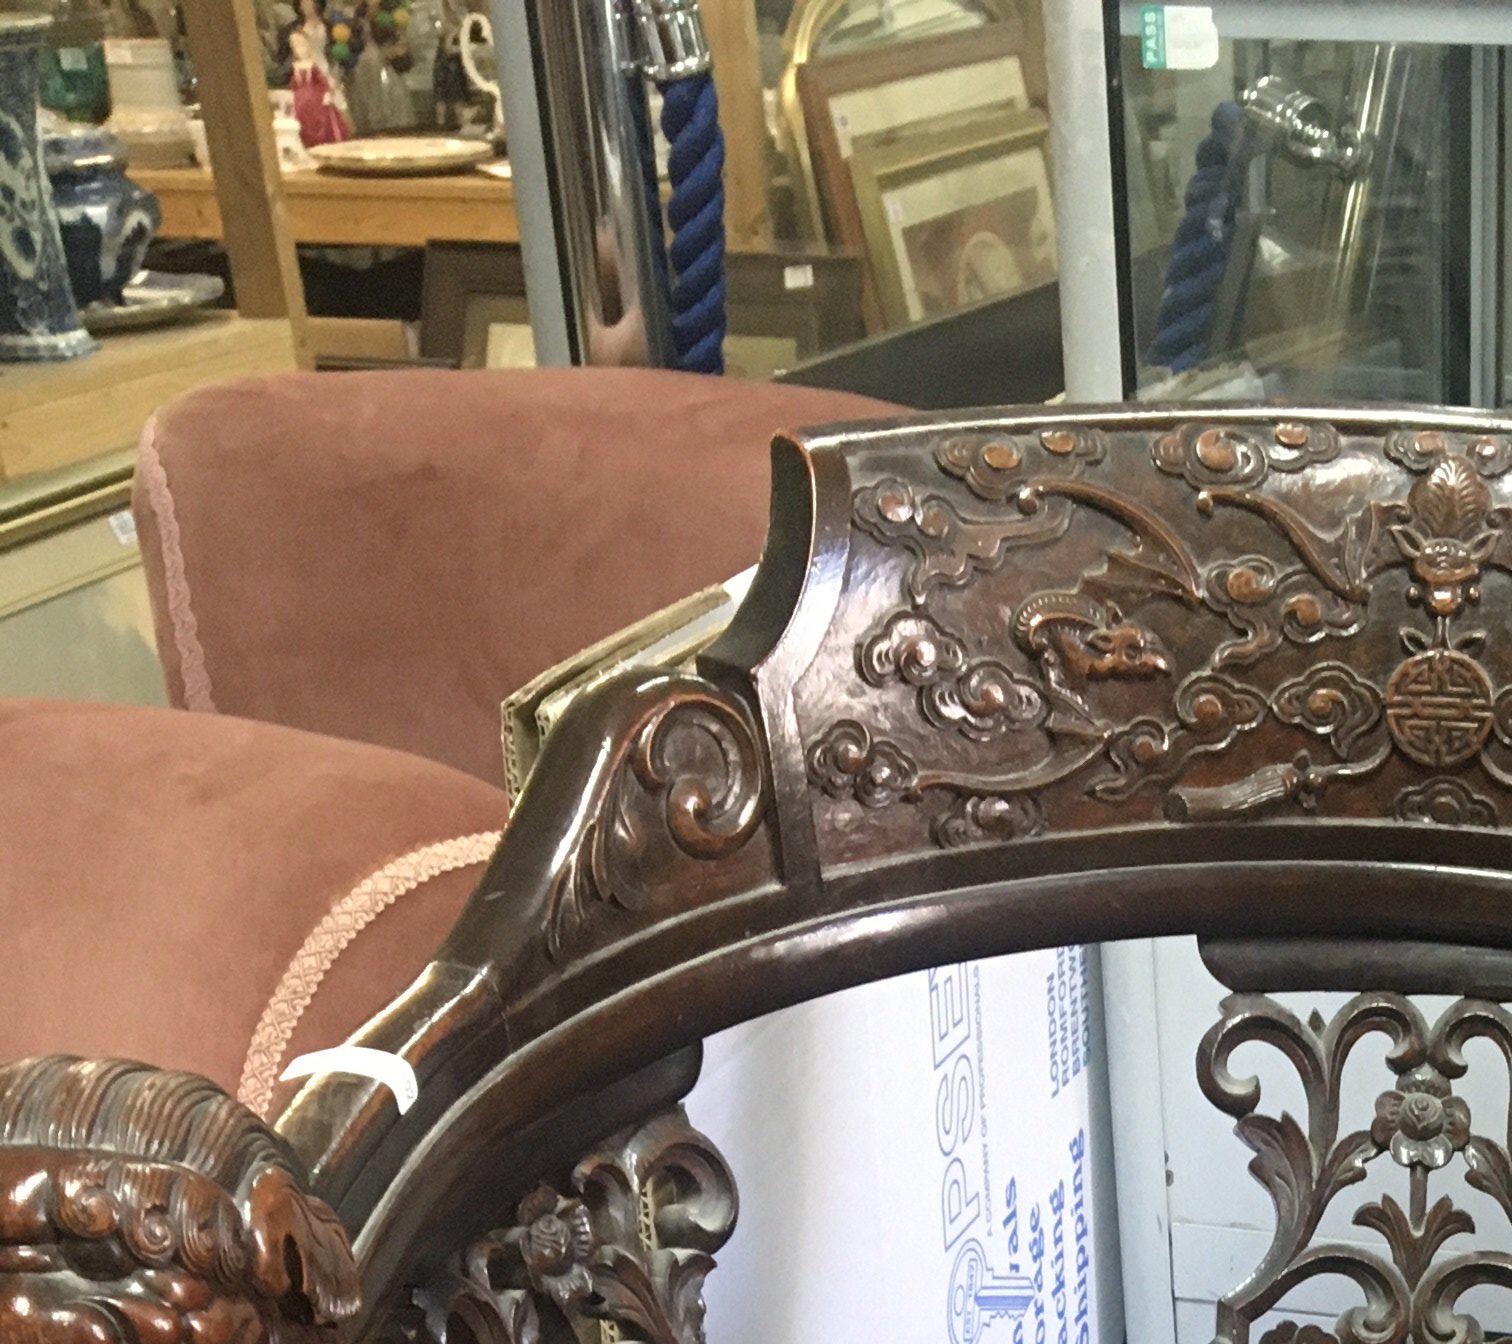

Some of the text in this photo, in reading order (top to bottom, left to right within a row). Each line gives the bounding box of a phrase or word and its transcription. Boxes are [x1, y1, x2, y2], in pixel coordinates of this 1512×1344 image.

[1144, 11, 1158, 63] PASS
[1046, 972, 1060, 1100] LONDON
[982, 1142, 993, 1224] COMPANY
